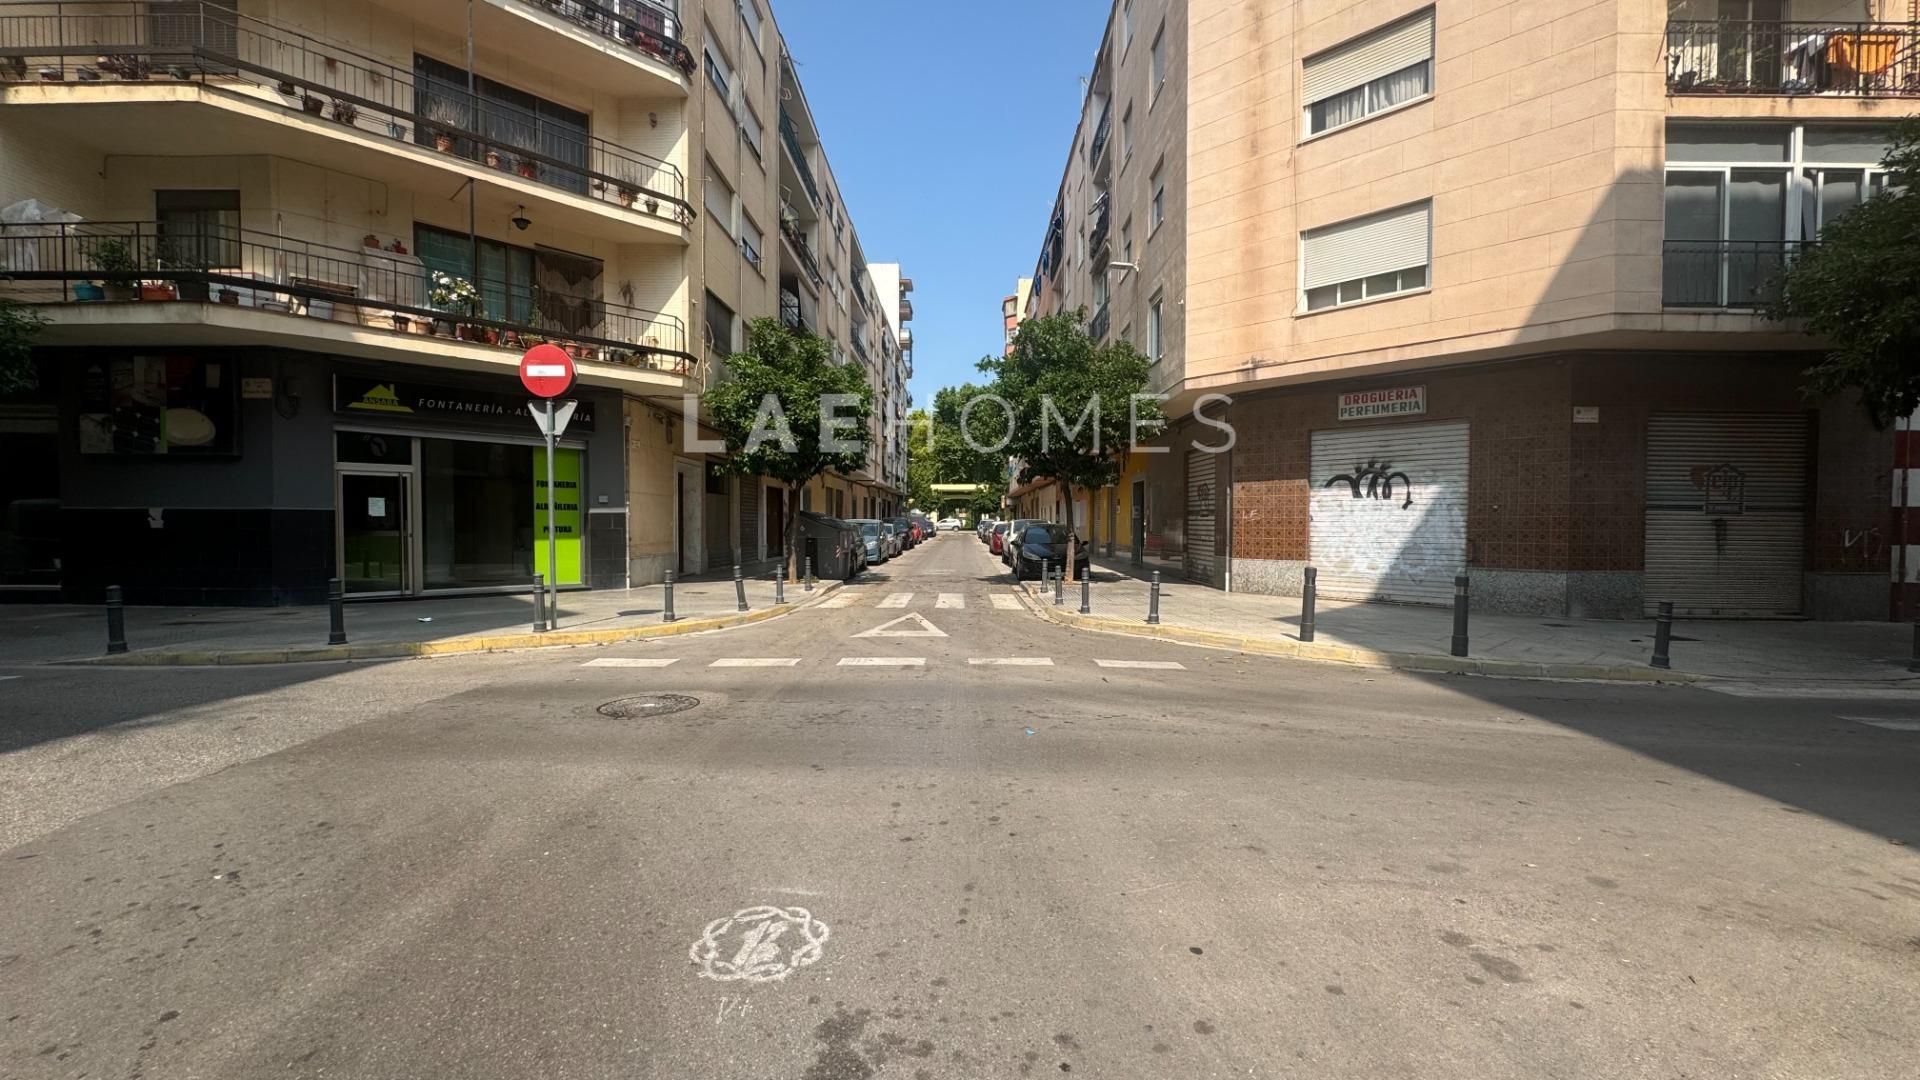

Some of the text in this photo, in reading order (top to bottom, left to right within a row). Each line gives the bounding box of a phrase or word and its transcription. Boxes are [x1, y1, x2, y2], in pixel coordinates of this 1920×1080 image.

[1344, 389, 1418, 406] DROGUERIA
[1340, 400, 1421, 417] PERFUMERIA
[536, 480, 577, 488] FONANERIA
[536, 502, 578, 511] ALBÑILERIA
